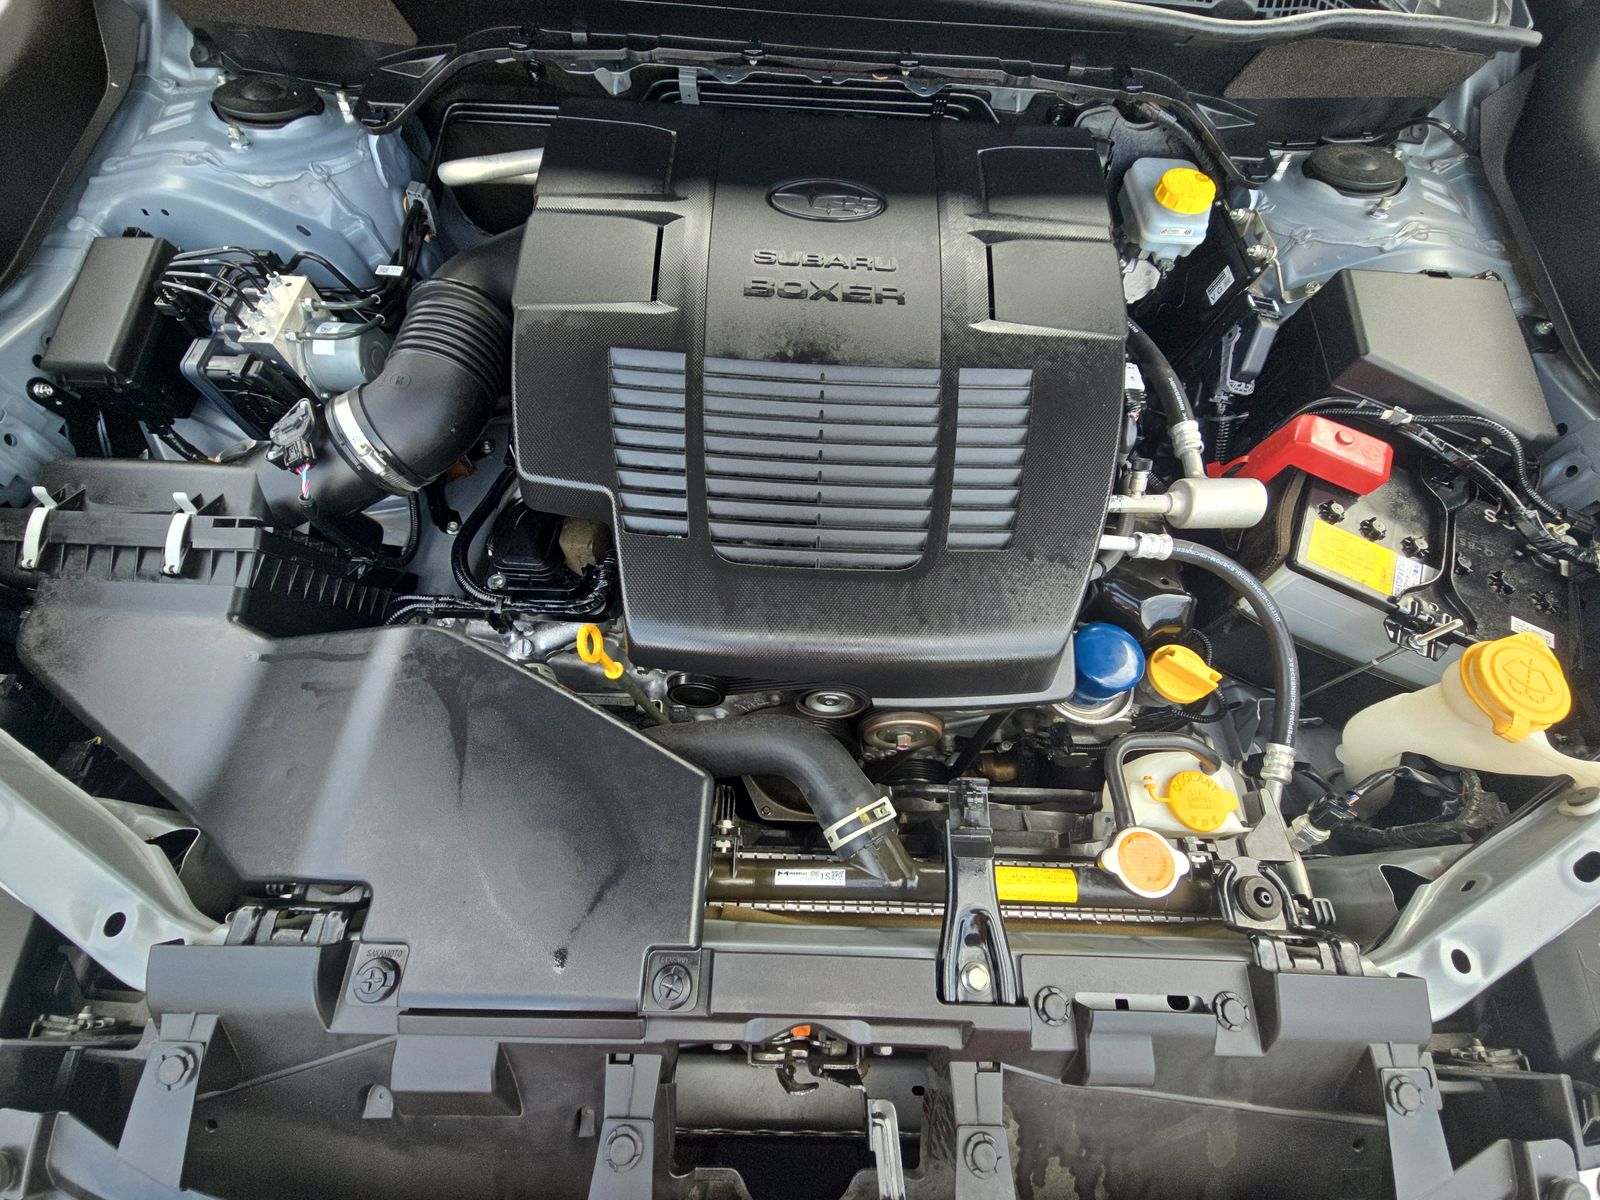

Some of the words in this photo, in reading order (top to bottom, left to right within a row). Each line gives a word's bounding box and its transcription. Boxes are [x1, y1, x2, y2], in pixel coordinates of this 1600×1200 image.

[753, 249, 897, 272] SUBARU
[743, 277, 906, 305] BOXER
[1172, 773, 1220, 792] COOLANT
